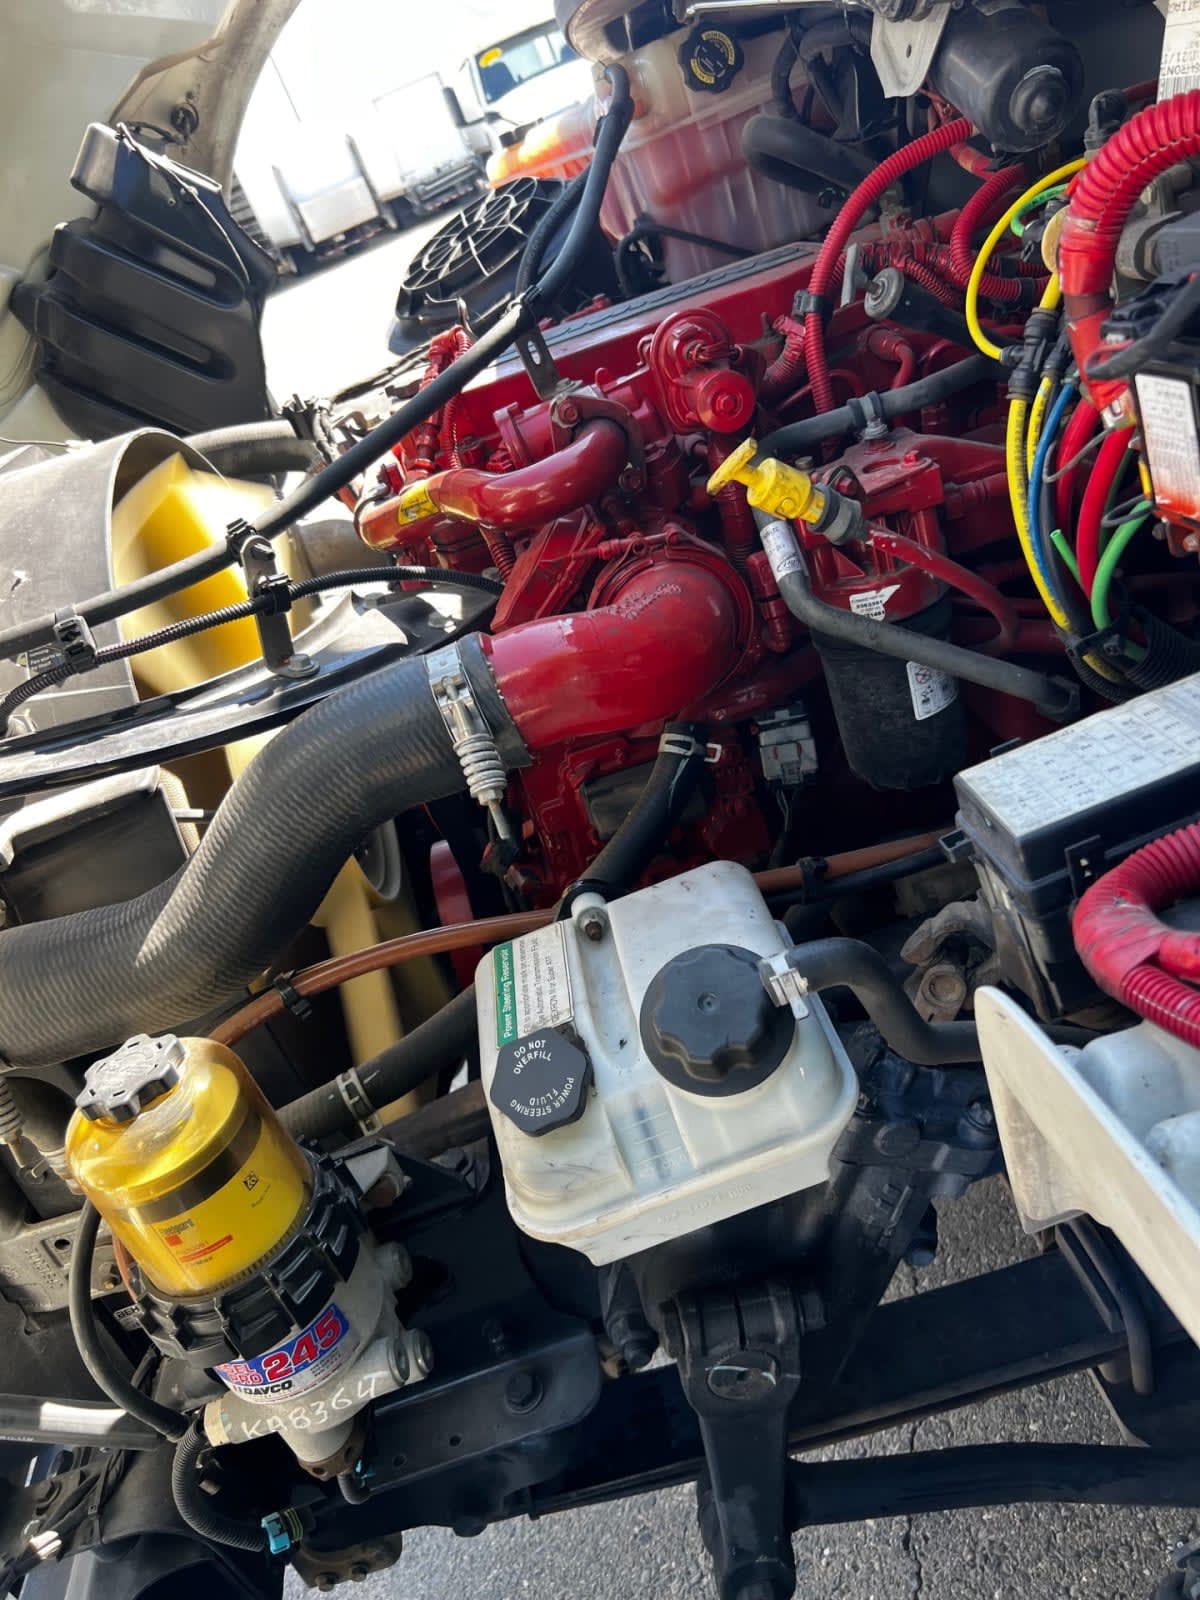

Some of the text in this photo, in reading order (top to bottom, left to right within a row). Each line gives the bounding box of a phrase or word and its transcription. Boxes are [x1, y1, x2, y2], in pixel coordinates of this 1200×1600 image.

[500, 948, 513, 1038] Power Steering Reservoir
[513, 1050, 552, 1075] OVERFILL
[514, 1040, 546, 1058] DO NOT
[510, 1077, 574, 1117] POWER STEERING
[529, 1088, 559, 1106] FLUID
[262, 1310, 342, 1382] 245
